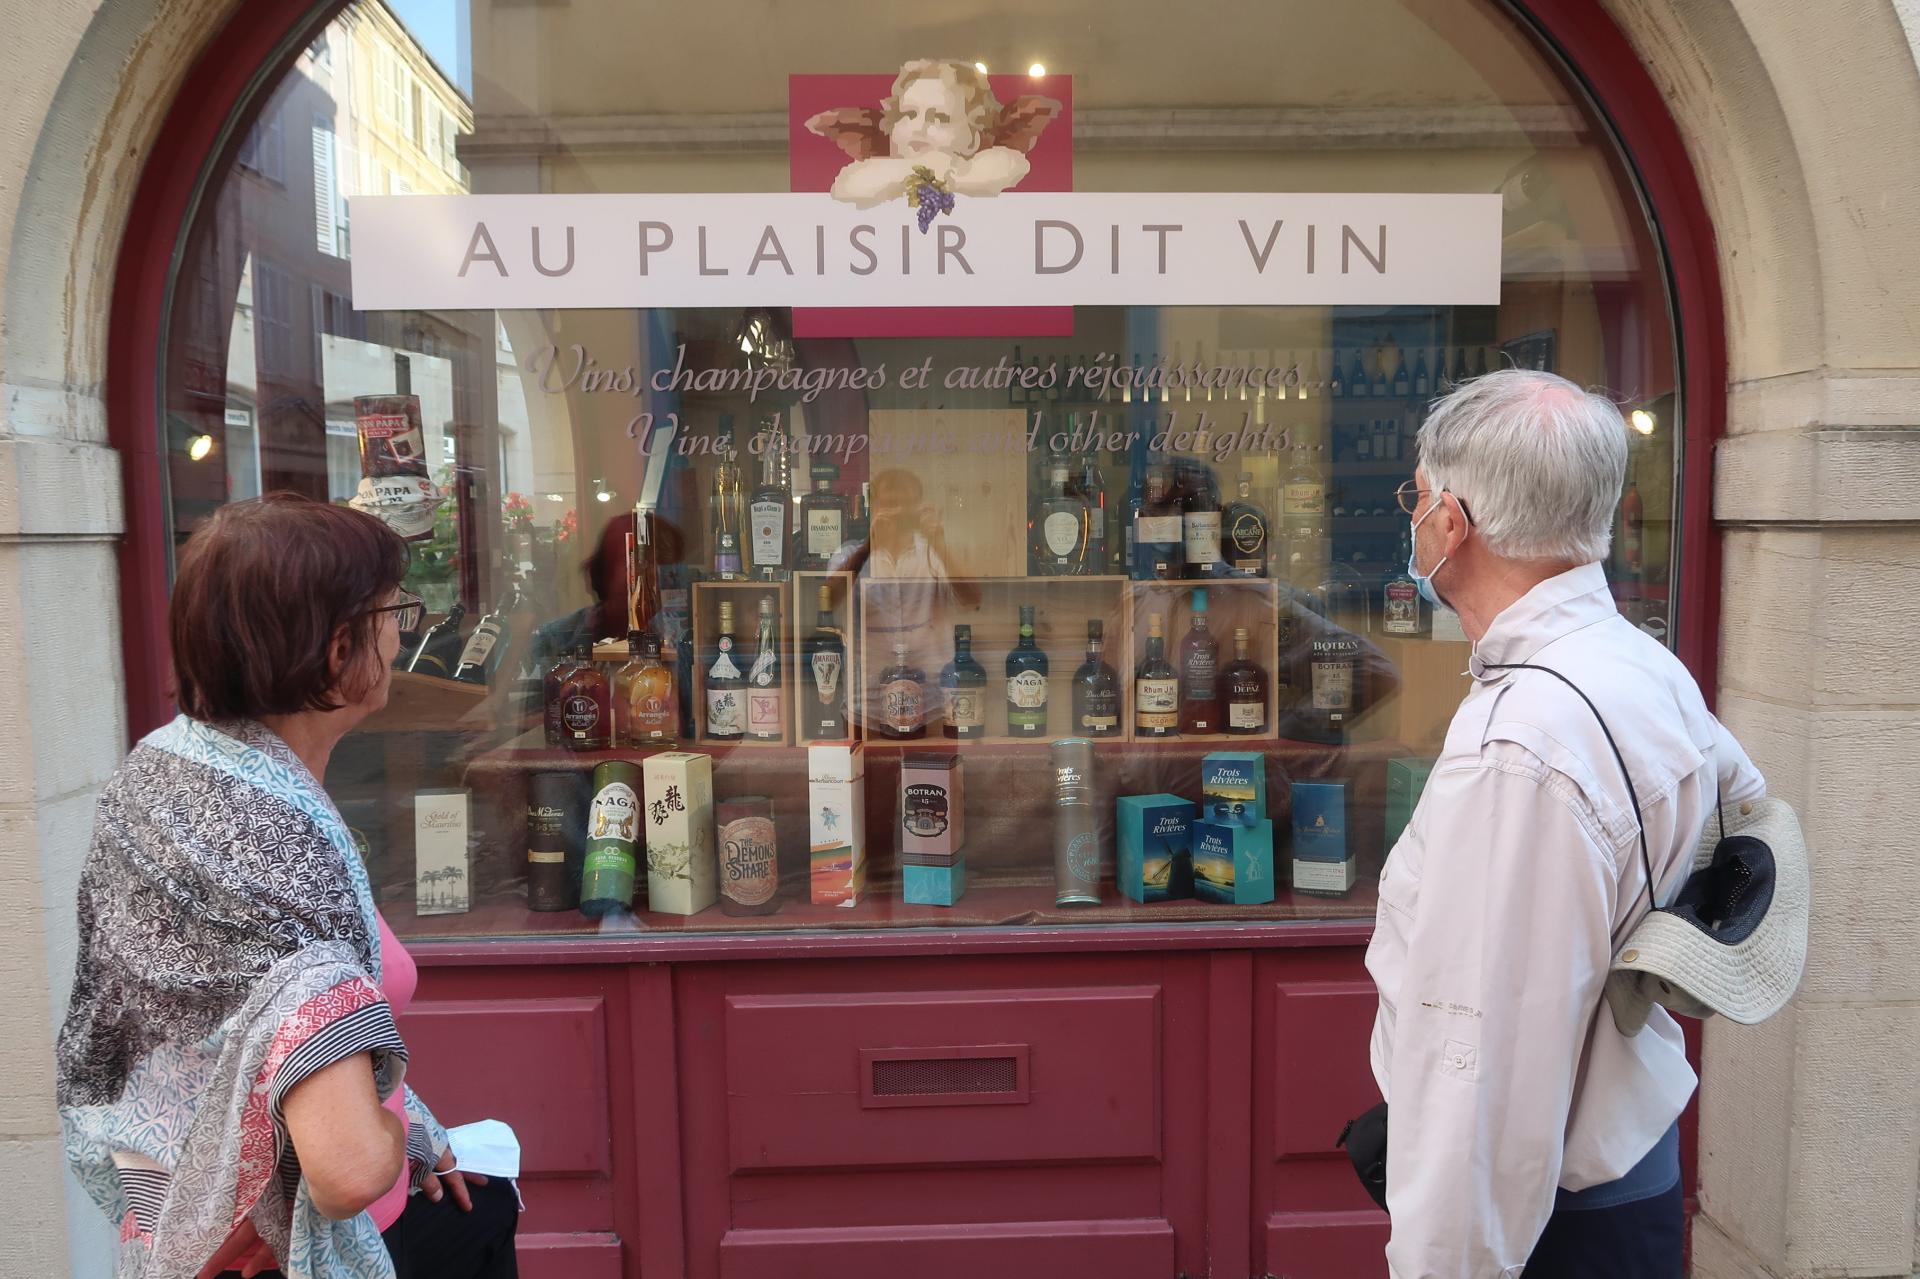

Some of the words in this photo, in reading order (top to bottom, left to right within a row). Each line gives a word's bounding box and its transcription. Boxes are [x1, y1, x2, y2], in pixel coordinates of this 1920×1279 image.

[457, 220, 577, 278] AU
[638, 220, 976, 277] PLAISIR
[1034, 218, 1184, 275] DIT
[1237, 218, 1388, 275] VIN
[525, 343, 641, 398] Vins,
[651, 345, 887, 405] champagnes
[900, 356, 933, 390] et
[944, 355, 1058, 390] autres
[1066, 351, 1339, 402] réjouissances...
[1049, 411, 1141, 453] other
[1149, 409, 1326, 462] delights...
[375, 486, 411, 496] PAPA
[1235, 528, 1261, 536] ARCANE
[1313, 641, 1359, 651] BOTRAN
[1143, 686, 1163, 694] Rhum
[1217, 767, 1241, 777] Trois
[1210, 775, 1249, 785] Rivières
[907, 788, 943, 796] BOTRAN
[595, 796, 637, 811] NAGA
[1159, 816, 1180, 826] Trois
[1153, 824, 1186, 834] Rivières
[740, 837, 753, 847] THE
[1205, 834, 1222, 845] Trois
[1200, 841, 1228, 854] Rivières
[726, 857, 769, 881] SHARE
